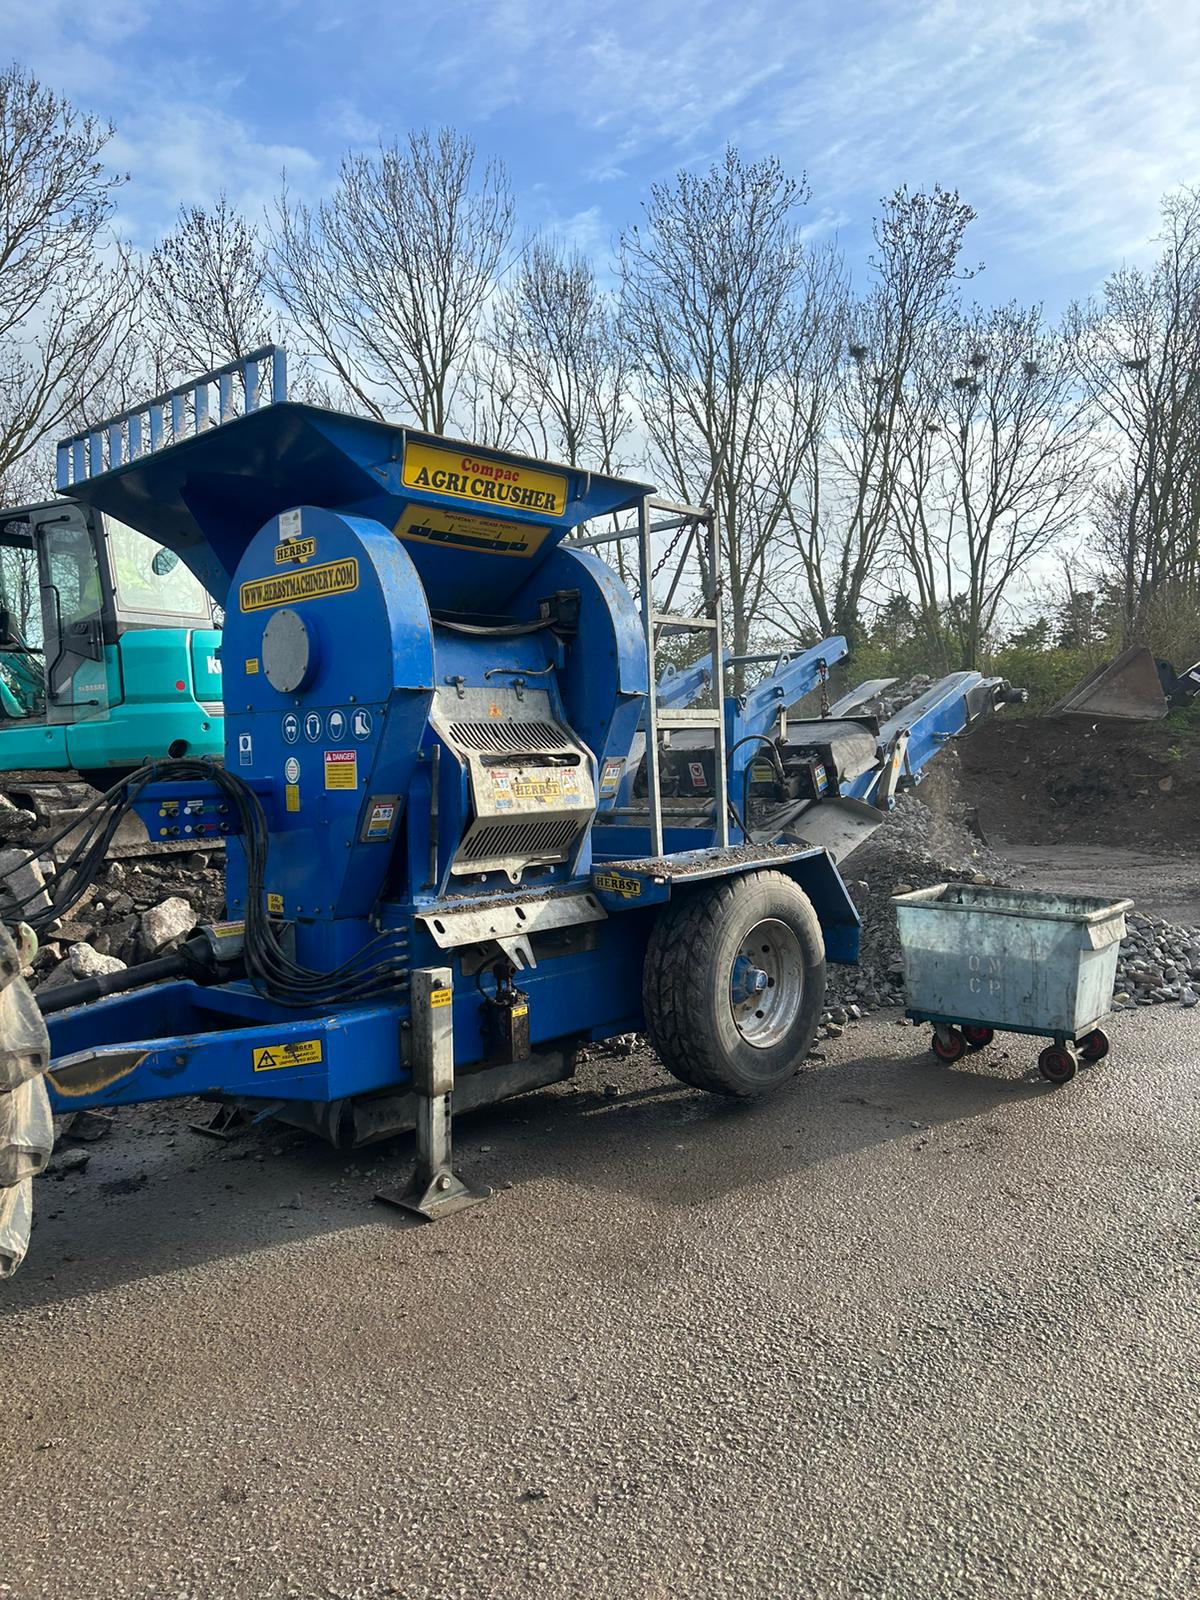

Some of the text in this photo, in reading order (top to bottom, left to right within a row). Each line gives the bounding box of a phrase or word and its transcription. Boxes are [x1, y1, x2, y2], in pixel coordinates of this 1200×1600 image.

[461, 457, 520, 482] Compac
[277, 541, 313, 560] HERBST
[244, 564, 353, 606] WWW.HERBSTMACHINERY.COM
[332, 752, 355, 761] DANGER
[516, 784, 558, 796] HERBST
[596, 876, 639, 892] HERBST
